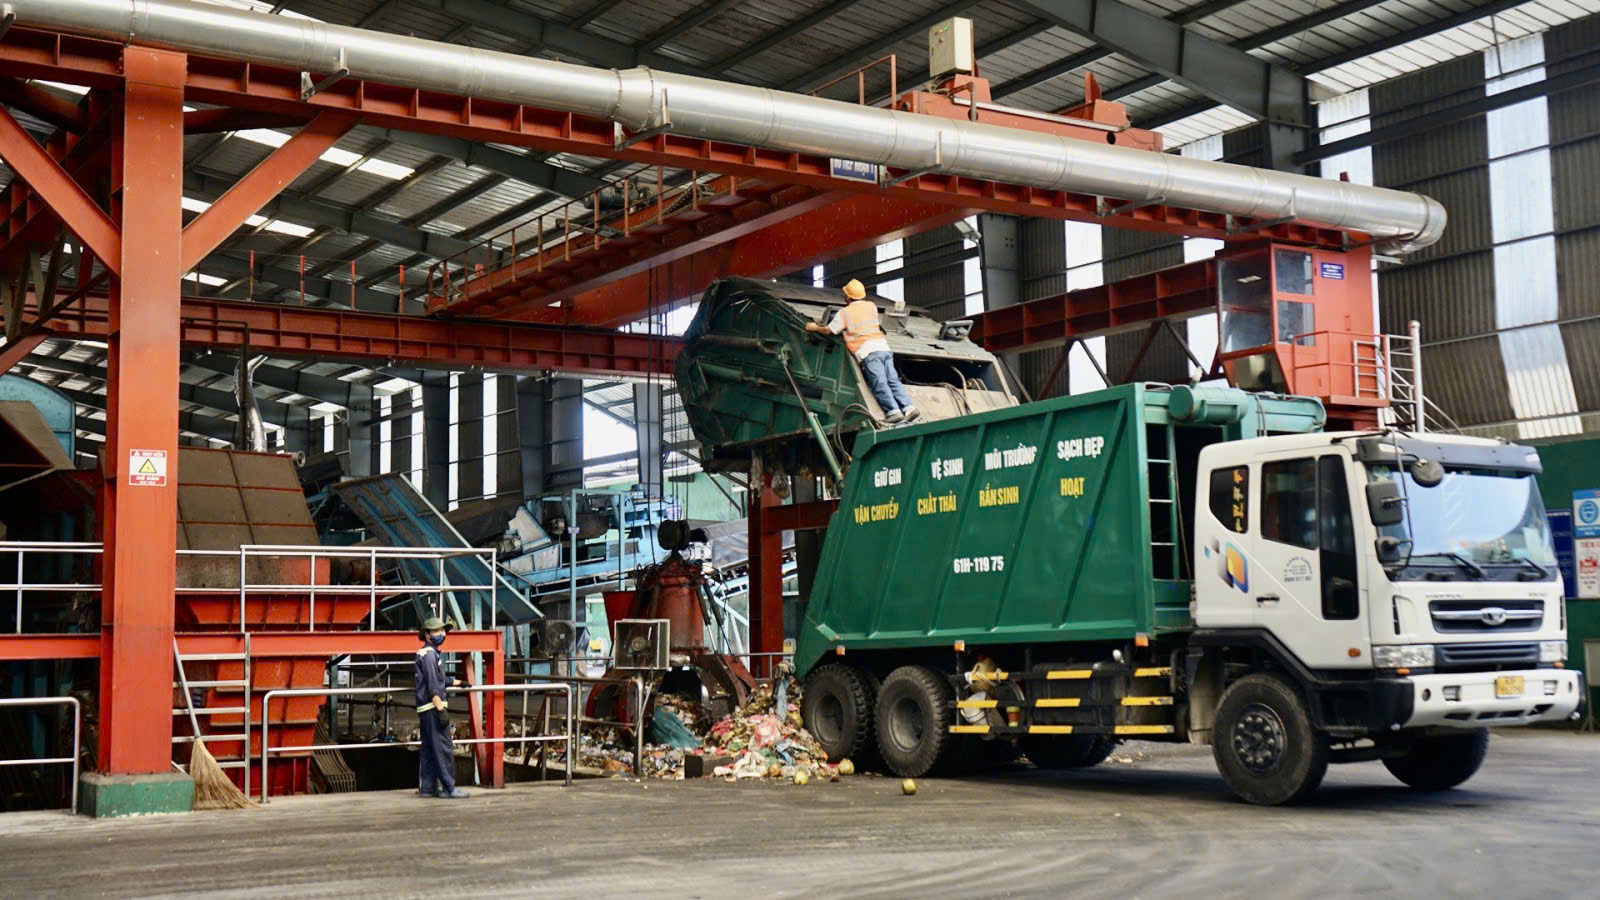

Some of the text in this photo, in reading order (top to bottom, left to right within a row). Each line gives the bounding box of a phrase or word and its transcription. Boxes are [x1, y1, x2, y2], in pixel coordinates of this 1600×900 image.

[931, 458, 942, 480] VỆ
[943, 457, 963, 477] SINH
[985, 448, 1001, 470] MÔI
[1057, 440, 1083, 461] SẠCH
[854, 504, 870, 525] VẬN
[918, 491, 937, 515] CHẤT
[938, 490, 957, 512] THẢI
[997, 486, 1019, 505] SINH
[1060, 477, 1084, 498] HOẠT
[953, 555, 1005, 574] 61H-119 75
